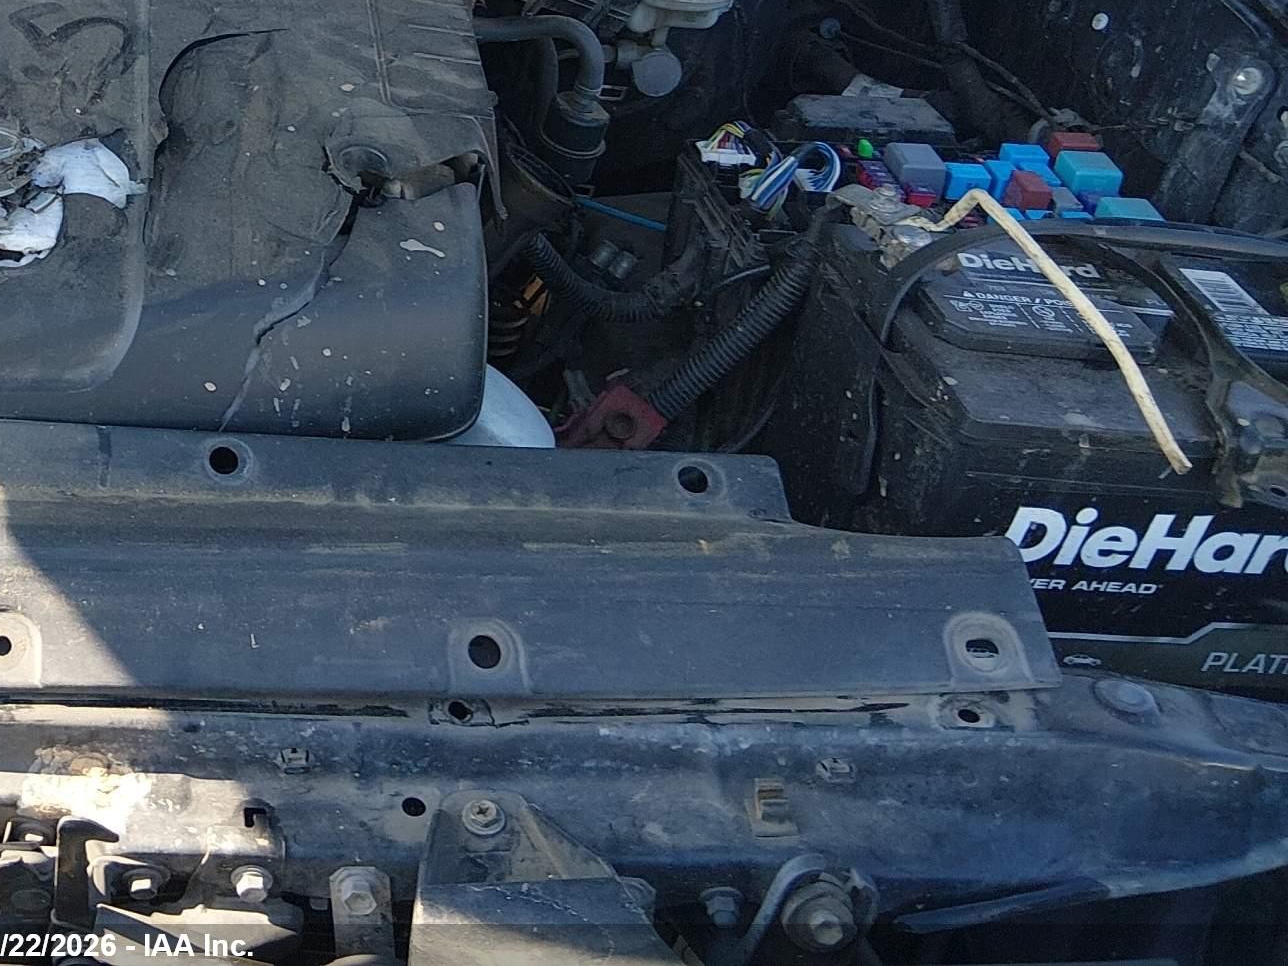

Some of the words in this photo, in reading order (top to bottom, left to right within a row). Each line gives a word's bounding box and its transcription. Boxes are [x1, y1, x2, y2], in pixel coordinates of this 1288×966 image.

[956, 252, 1101, 279] DieHrd
[975, 292, 1032, 302] DANGER
[1005, 506, 1288, 574] DieHar
[1071, 580, 1158, 594] AHEAD
